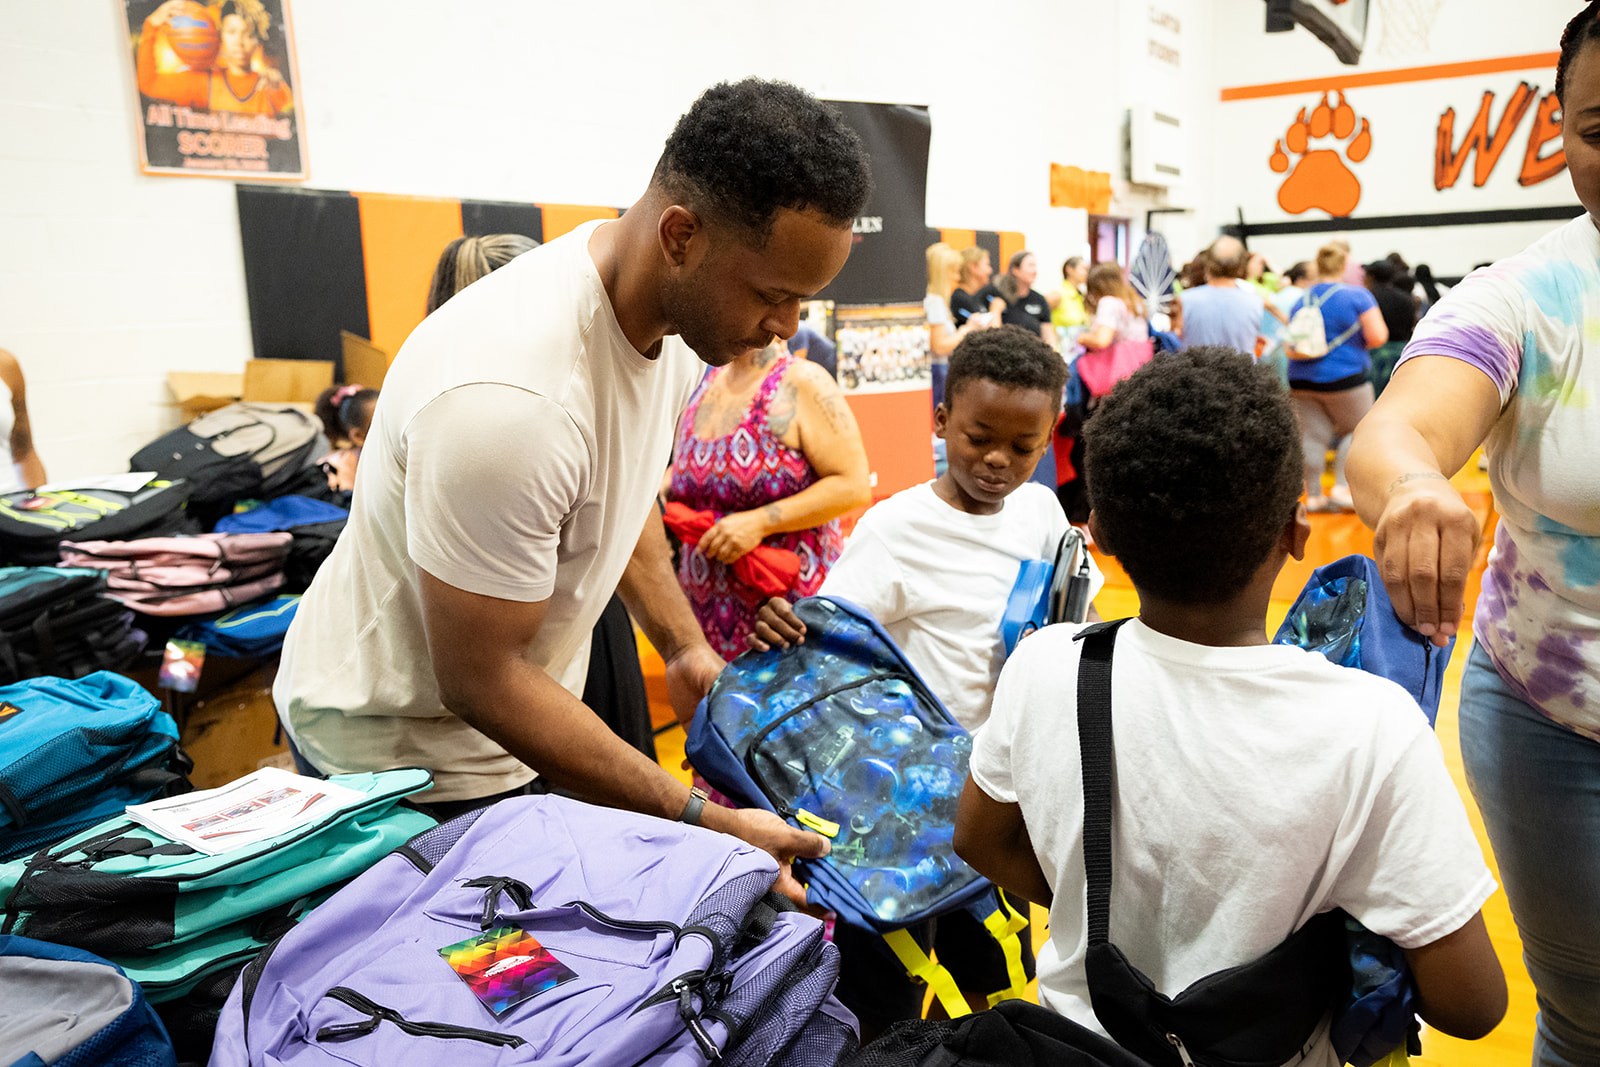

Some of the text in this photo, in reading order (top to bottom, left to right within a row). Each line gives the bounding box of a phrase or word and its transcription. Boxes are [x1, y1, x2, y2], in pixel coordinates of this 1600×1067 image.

[146, 104, 292, 140] All Time Leading
[177, 131, 268, 158] SCORER
